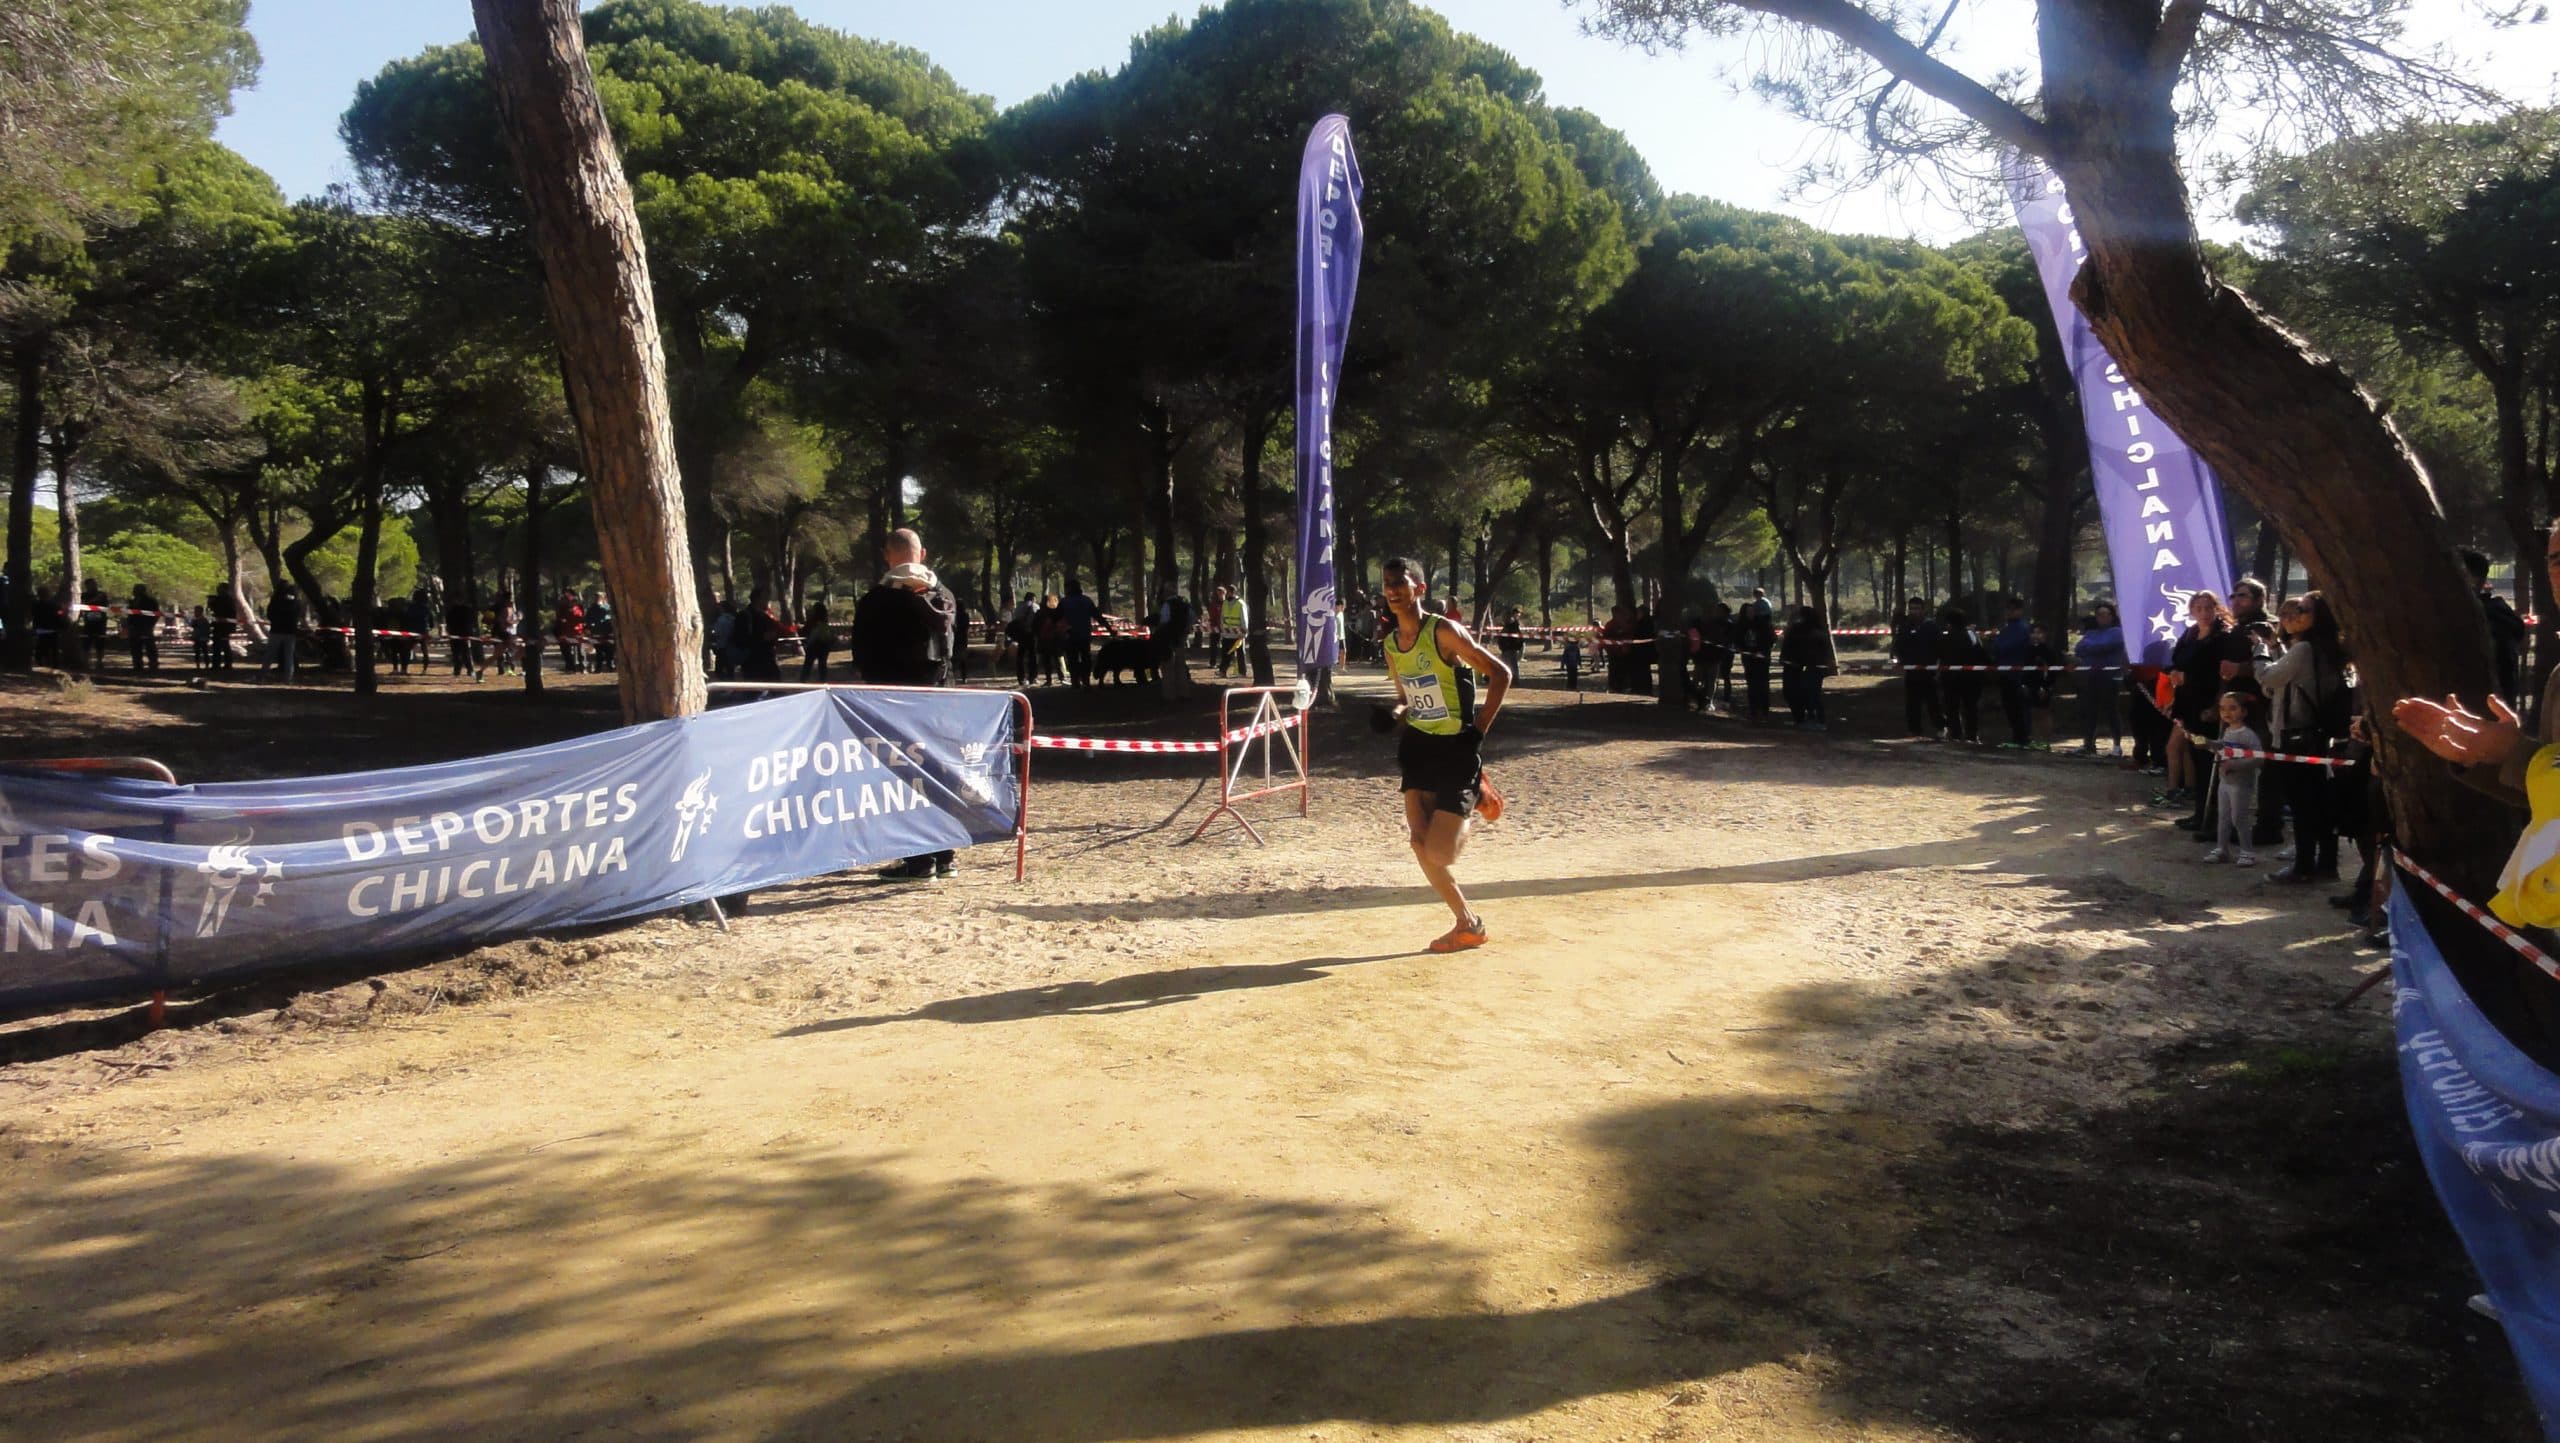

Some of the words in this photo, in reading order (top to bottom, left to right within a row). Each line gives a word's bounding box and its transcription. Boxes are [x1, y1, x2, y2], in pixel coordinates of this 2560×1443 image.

[747, 737, 926, 793] DEPORTES
[342, 783, 638, 862] DEPORTES
[743, 777, 930, 839] CHICLANA
[347, 837, 628, 917] CHICLANA
